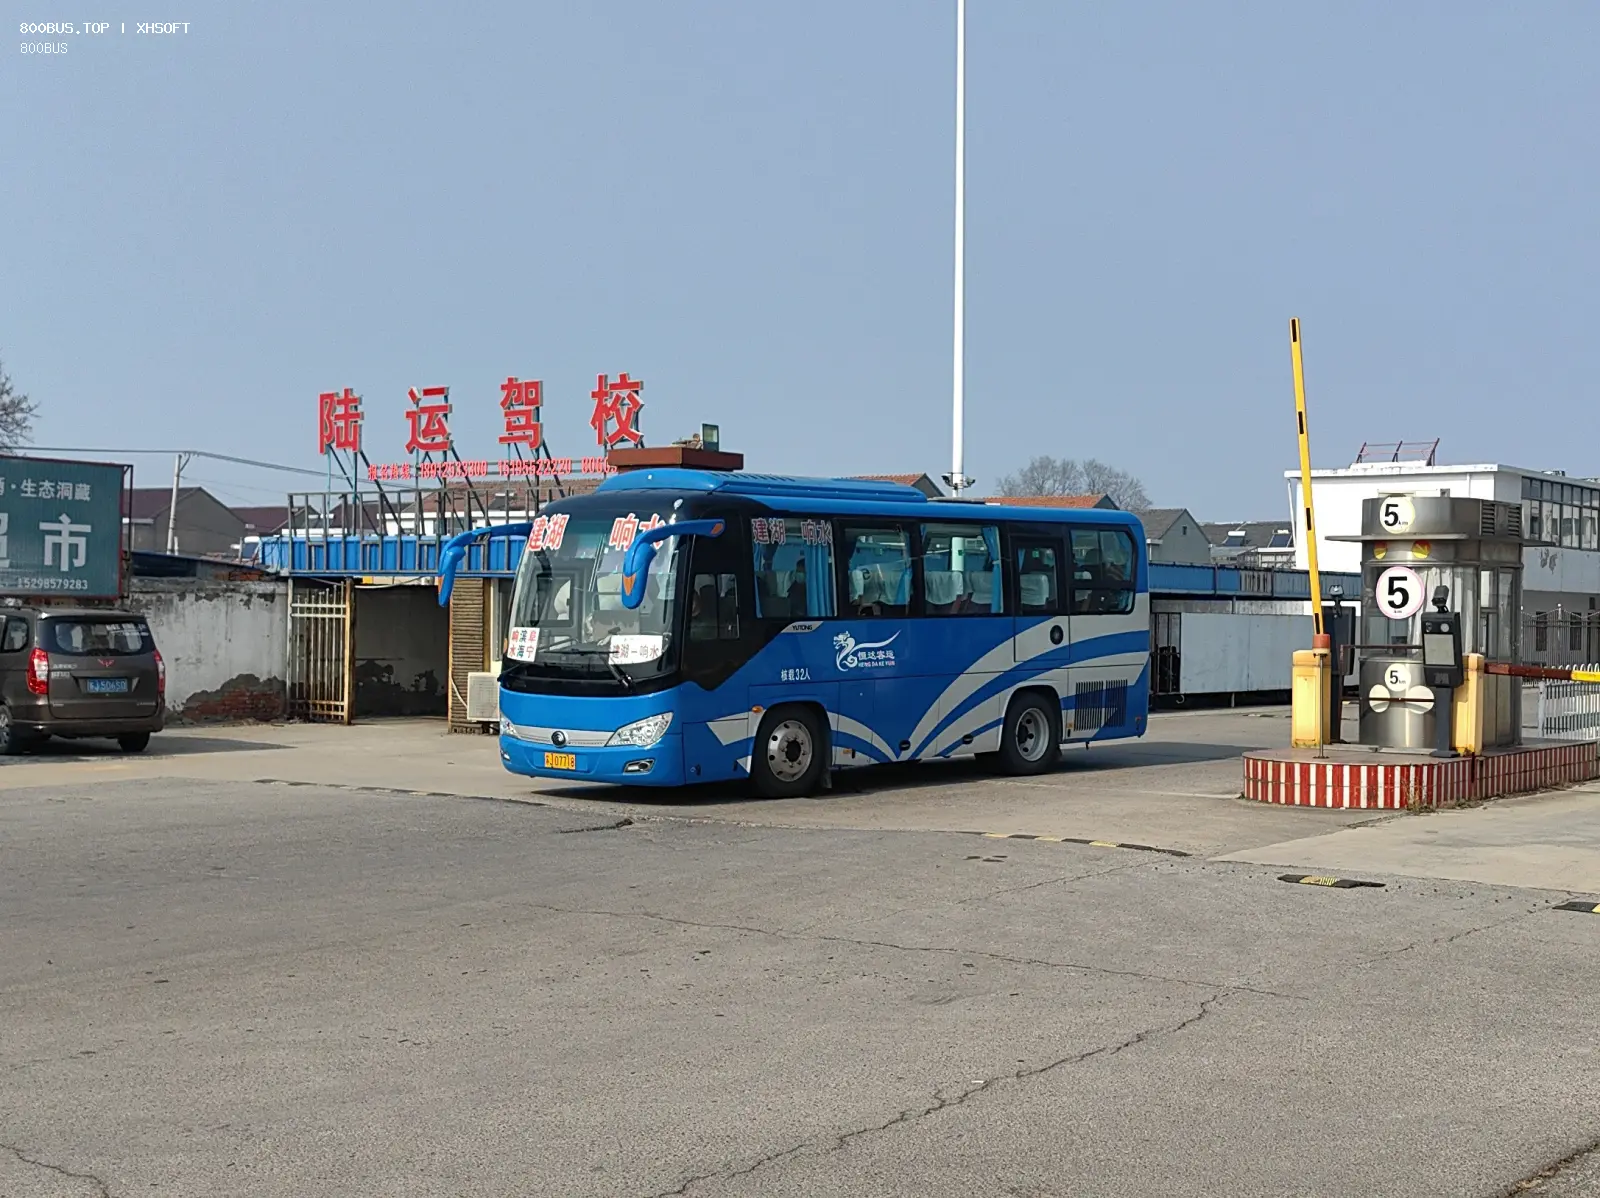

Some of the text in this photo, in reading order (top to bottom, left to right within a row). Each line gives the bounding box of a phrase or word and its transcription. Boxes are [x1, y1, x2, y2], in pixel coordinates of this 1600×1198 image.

[318, 371, 645, 455] 陆运驾校
[1383, 503, 1399, 527] 5
[528, 514, 569, 551] 建湖
[752, 518, 833, 546] 建湖 响水
[17, 577, 88, 590] 15298579283
[1387, 575, 1410, 609] 5
[792, 624, 813, 632] YUTONG
[1389, 670, 1399, 685] 5
